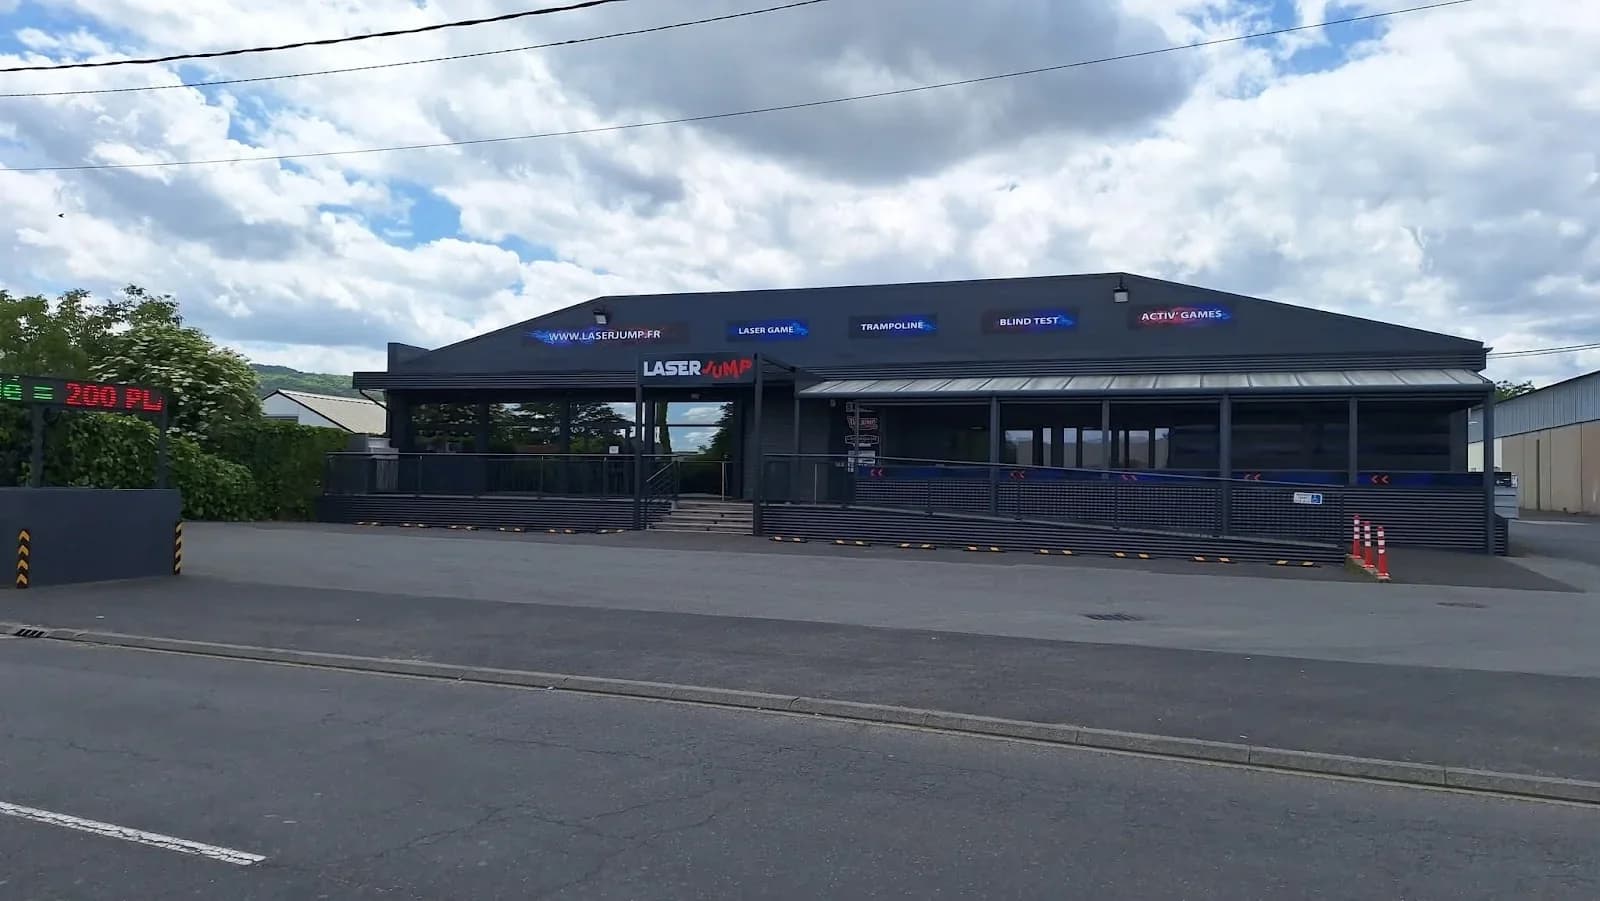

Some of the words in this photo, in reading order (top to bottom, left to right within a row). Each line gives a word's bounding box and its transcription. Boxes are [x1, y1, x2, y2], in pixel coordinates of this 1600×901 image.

[1141, 311, 1179, 321] ACTIV'
[1180, 309, 1222, 319] GAMES
[860, 320, 924, 331] TRAMPOLINE
[999, 317, 1030, 327] BLIND
[1034, 316, 1058, 325] TEST
[549, 329, 661, 341] WWW.LASERJUMP.FR
[738, 326, 767, 335] LASER
[767, 325, 794, 334] GAME
[643, 359, 701, 377] LASER
[701, 358, 753, 379] JUMP
[65, 382, 117, 408] 200
[125, 387, 163, 411] PL
